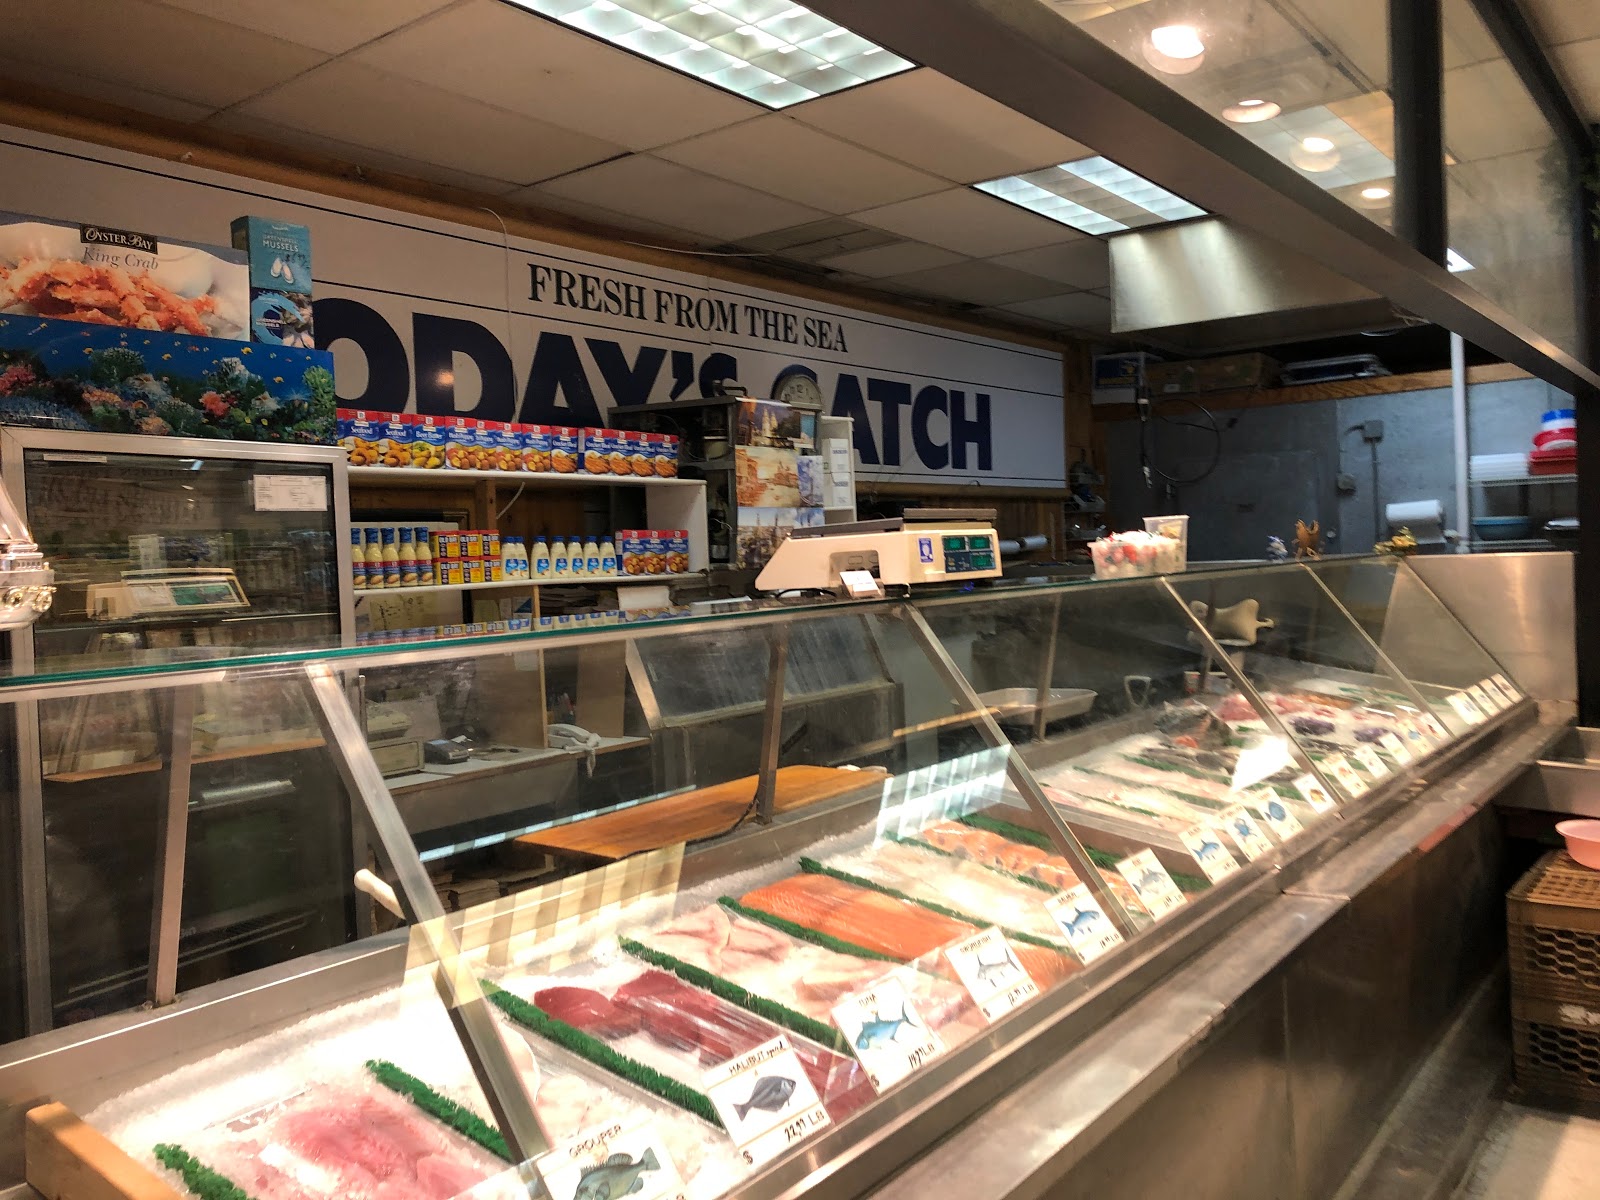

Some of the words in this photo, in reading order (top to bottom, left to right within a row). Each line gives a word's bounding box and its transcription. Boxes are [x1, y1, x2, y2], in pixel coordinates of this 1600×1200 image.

[85, 227, 128, 245] OYSTER
[126, 233, 154, 251] BAY
[262, 240, 299, 253] MUSSELS
[83, 246, 120, 270] King
[124, 253, 159, 271] Crab
[527, 263, 647, 321] FRESH
[653, 288, 739, 335] FROM
[744, 305, 798, 344] THE
[803, 316, 849, 353] SEA
[312, 298, 738, 425] ODAY'S
[351, 426, 373, 435] Seafood
[385, 428, 407, 437] Seafood
[729, 1050, 765, 1077] HALIBUT
[807, 1109, 825, 1126] LB
[568, 1124, 622, 1158] GROUPER
